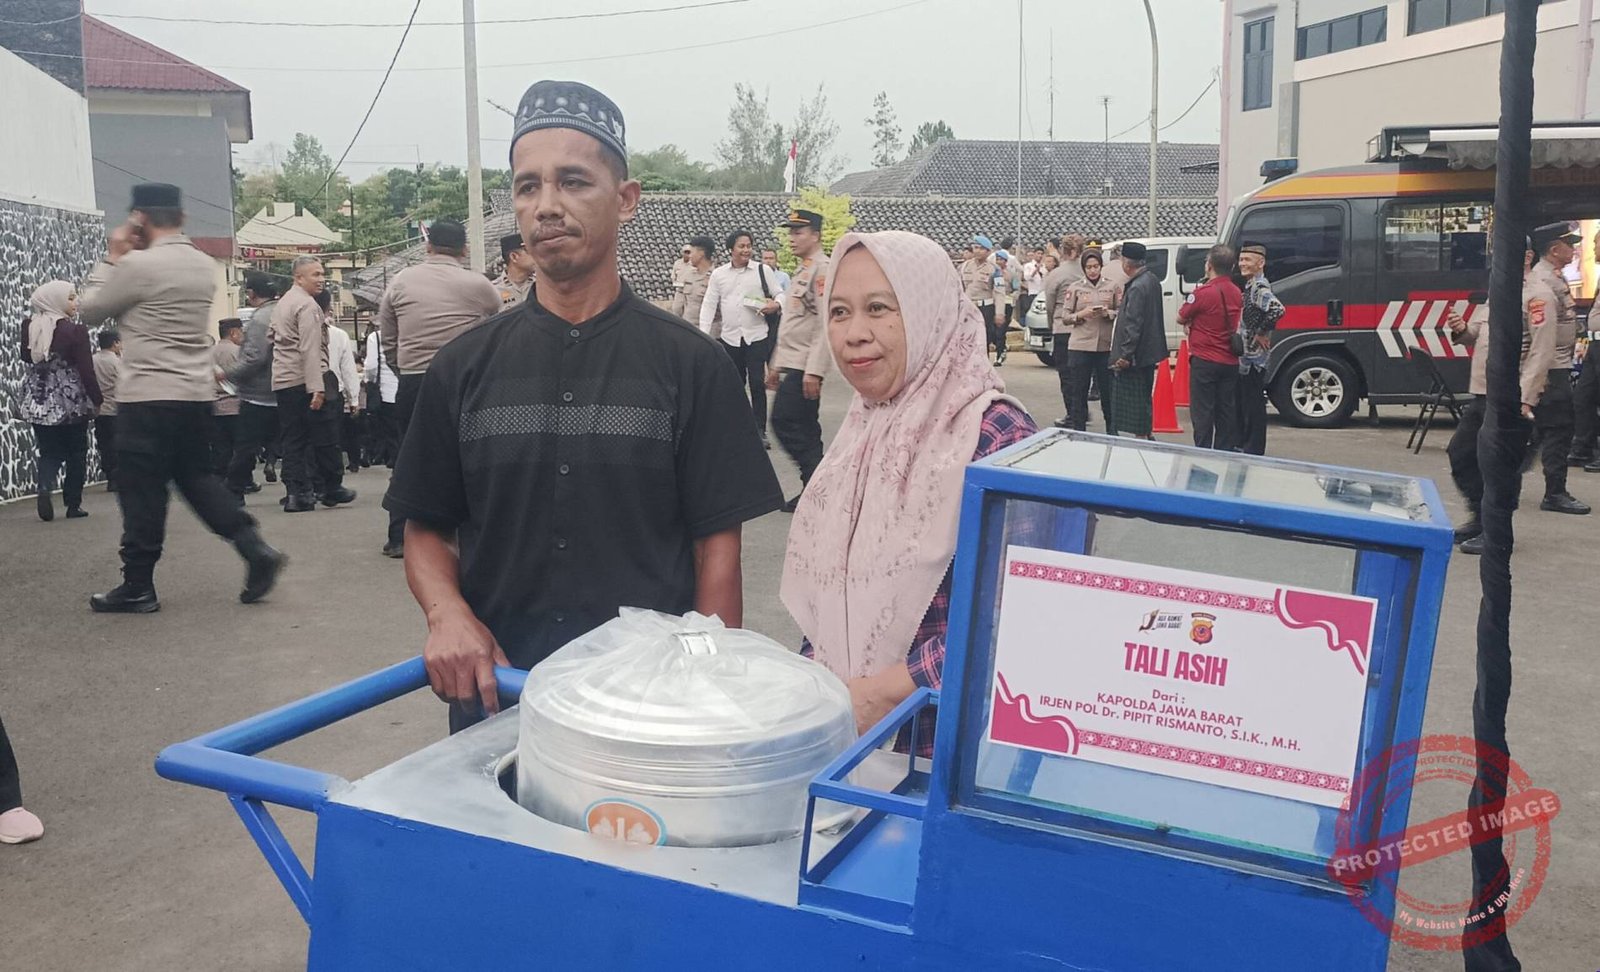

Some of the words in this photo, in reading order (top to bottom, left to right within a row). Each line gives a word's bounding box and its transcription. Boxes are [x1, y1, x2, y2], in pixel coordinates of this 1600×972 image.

[1124, 642, 1170, 677] TALI
[1173, 651, 1228, 687] ASIH
[1097, 692, 1157, 713] KAPOLDA
[1159, 703, 1197, 720] JAWA
[1200, 710, 1244, 727] BARAT
[1152, 689, 1178, 703] Dari
[1039, 695, 1072, 710] IRJEN
[1075, 701, 1099, 715] POL
[1102, 706, 1120, 719] Dr.
[1123, 709, 1153, 725] PIPIT
[1155, 715, 1227, 739] RISMANTO,
[1231, 729, 1268, 747] S.I.K.,
[1271, 736, 1301, 751] M.H.
